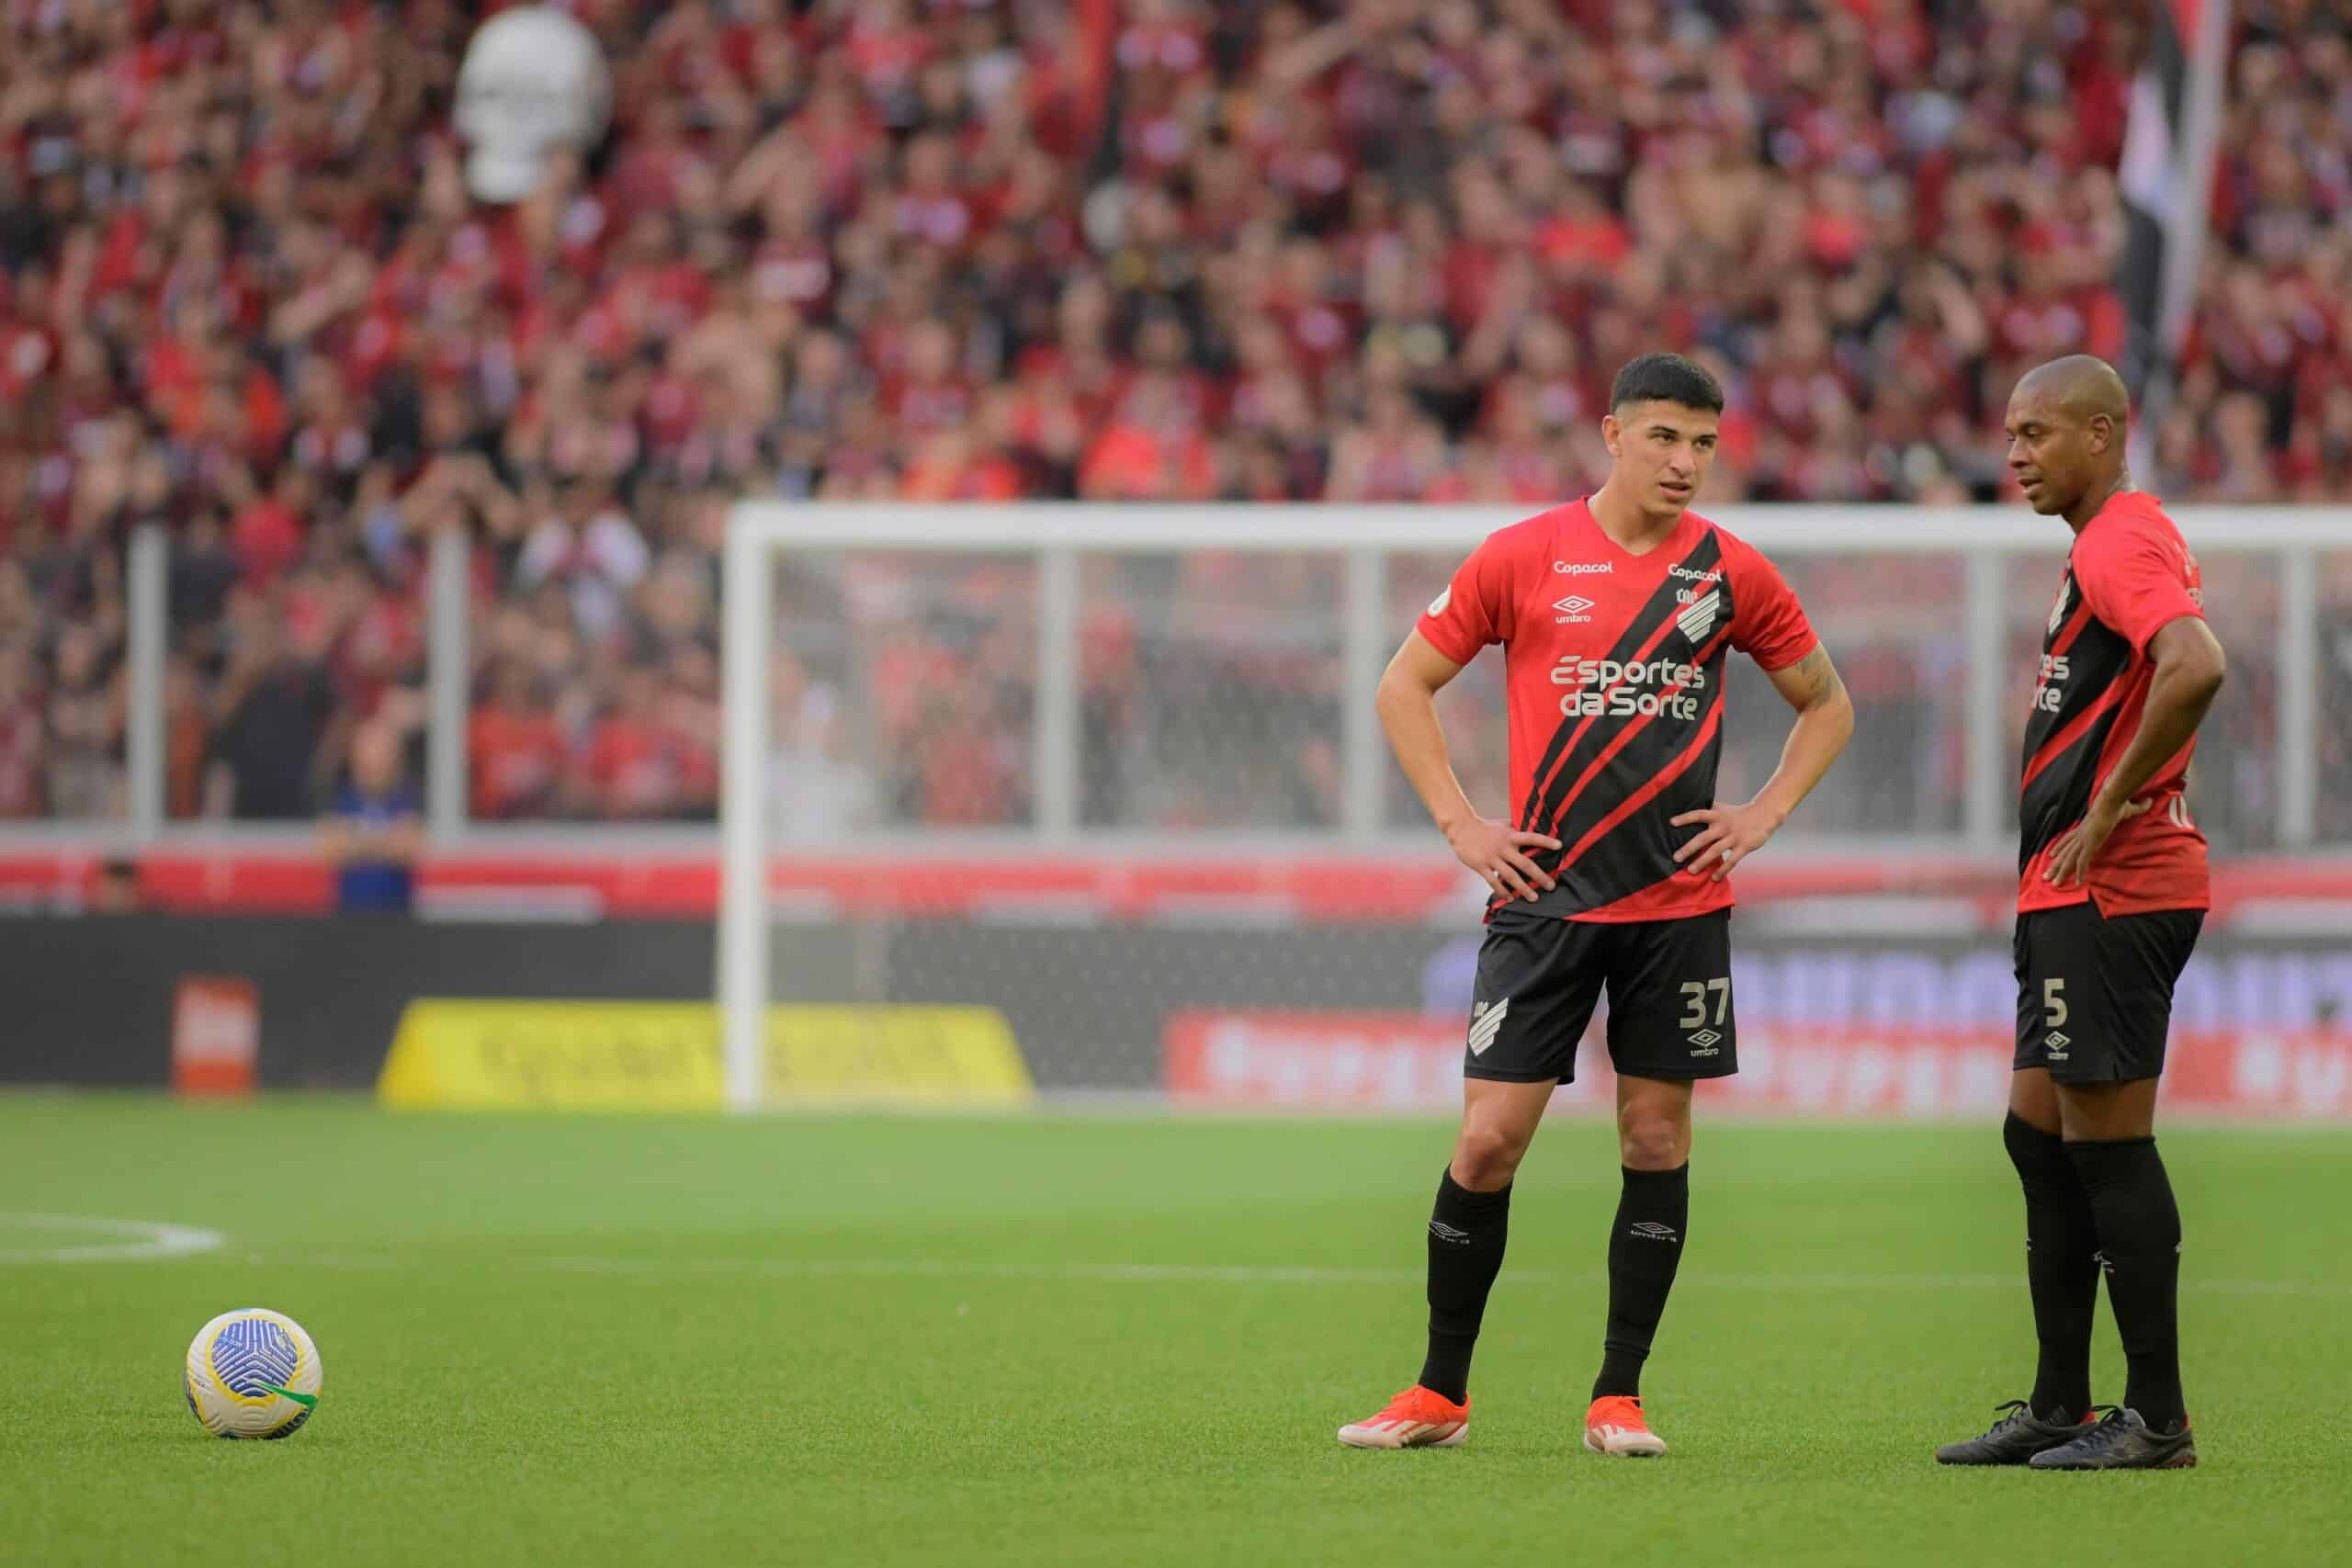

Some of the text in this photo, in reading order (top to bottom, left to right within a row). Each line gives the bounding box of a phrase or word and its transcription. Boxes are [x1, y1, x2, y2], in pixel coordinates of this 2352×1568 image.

[1554, 561, 1613, 577] Copacol
[1668, 563, 1723, 581] Copacol
[1556, 615, 1591, 624] umbro
[1550, 655, 1705, 691] Esportes
[1679, 977, 1730, 1028] 37
[2043, 978, 2068, 1027] 5
